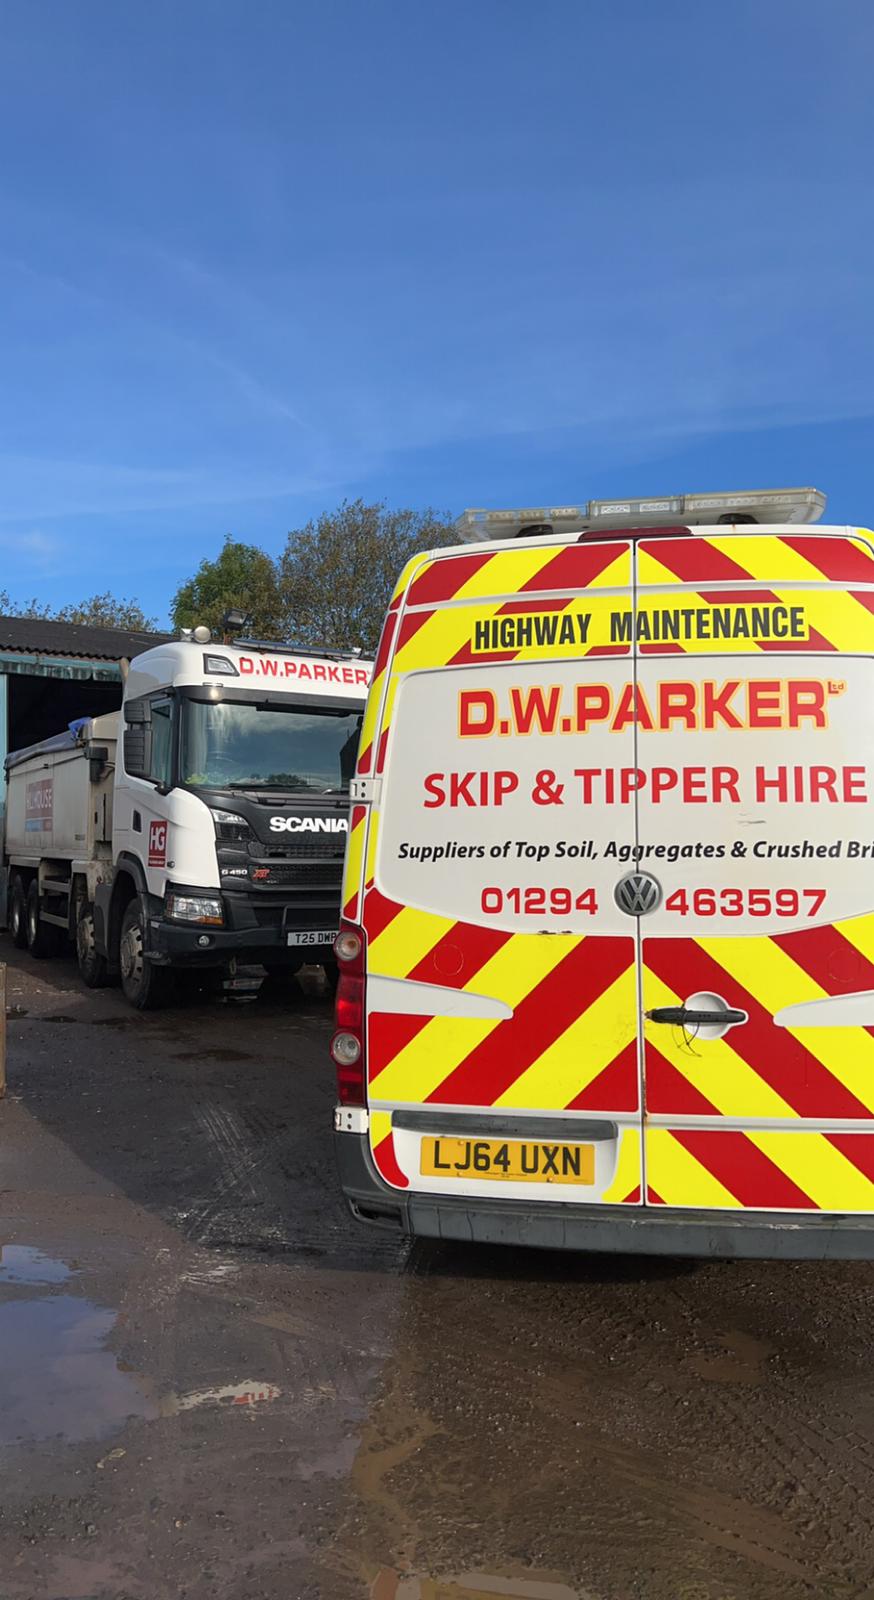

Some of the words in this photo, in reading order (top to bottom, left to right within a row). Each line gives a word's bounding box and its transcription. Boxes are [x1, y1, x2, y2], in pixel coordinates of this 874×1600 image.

[475, 613, 592, 650] HIGHWAY
[610, 606, 806, 642] MAINTENANCE
[239, 657, 368, 685] D.W.PARKER
[457, 677, 829, 739] D.W.PARKER
[423, 771, 519, 808] SKIP
[531, 769, 565, 806] &
[574, 766, 741, 804] TIPPER
[755, 766, 868, 803] HIRE
[150, 826, 165, 851] HG
[269, 816, 349, 832] SCANIA
[398, 841, 485, 863] Suppliers
[489, 841, 514, 858] of
[515, 841, 550, 862] Top
[554, 840, 599, 860] Soil,
[603, 840, 726, 862] Aggregates
[730, 840, 748, 858] &
[752, 840, 842, 859] Crushed
[480, 887, 599, 915] 01294
[665, 888, 827, 917] 463597
[295, 933, 315, 944] T25
[434, 1140, 511, 1172] LJ64
[521, 1144, 581, 1176] UXN
